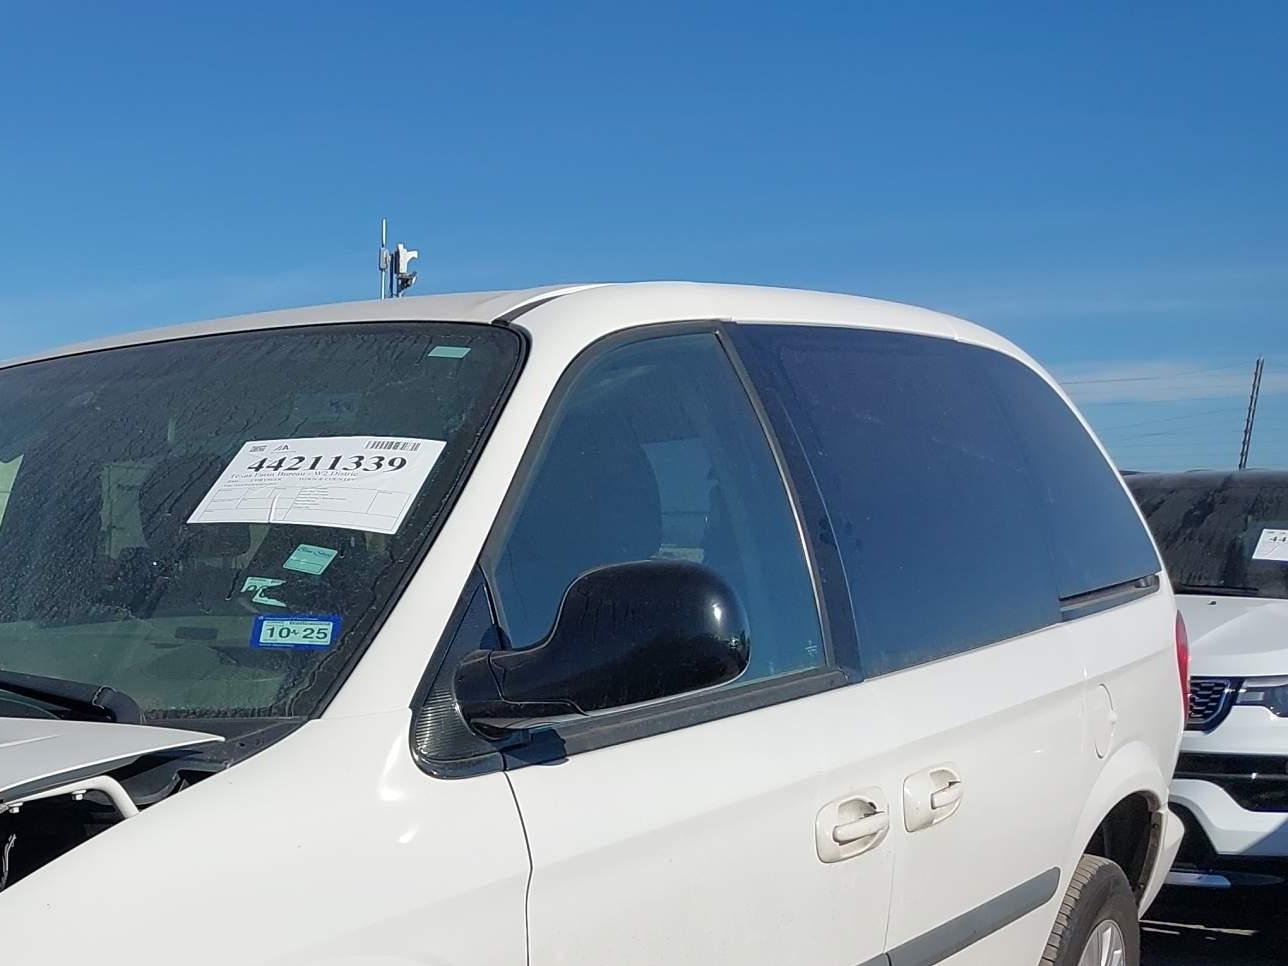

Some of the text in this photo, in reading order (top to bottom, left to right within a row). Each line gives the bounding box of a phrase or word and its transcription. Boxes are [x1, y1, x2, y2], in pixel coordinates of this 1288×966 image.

[247, 455, 407, 473] 44211339
[266, 627, 329, 639] 10 25
